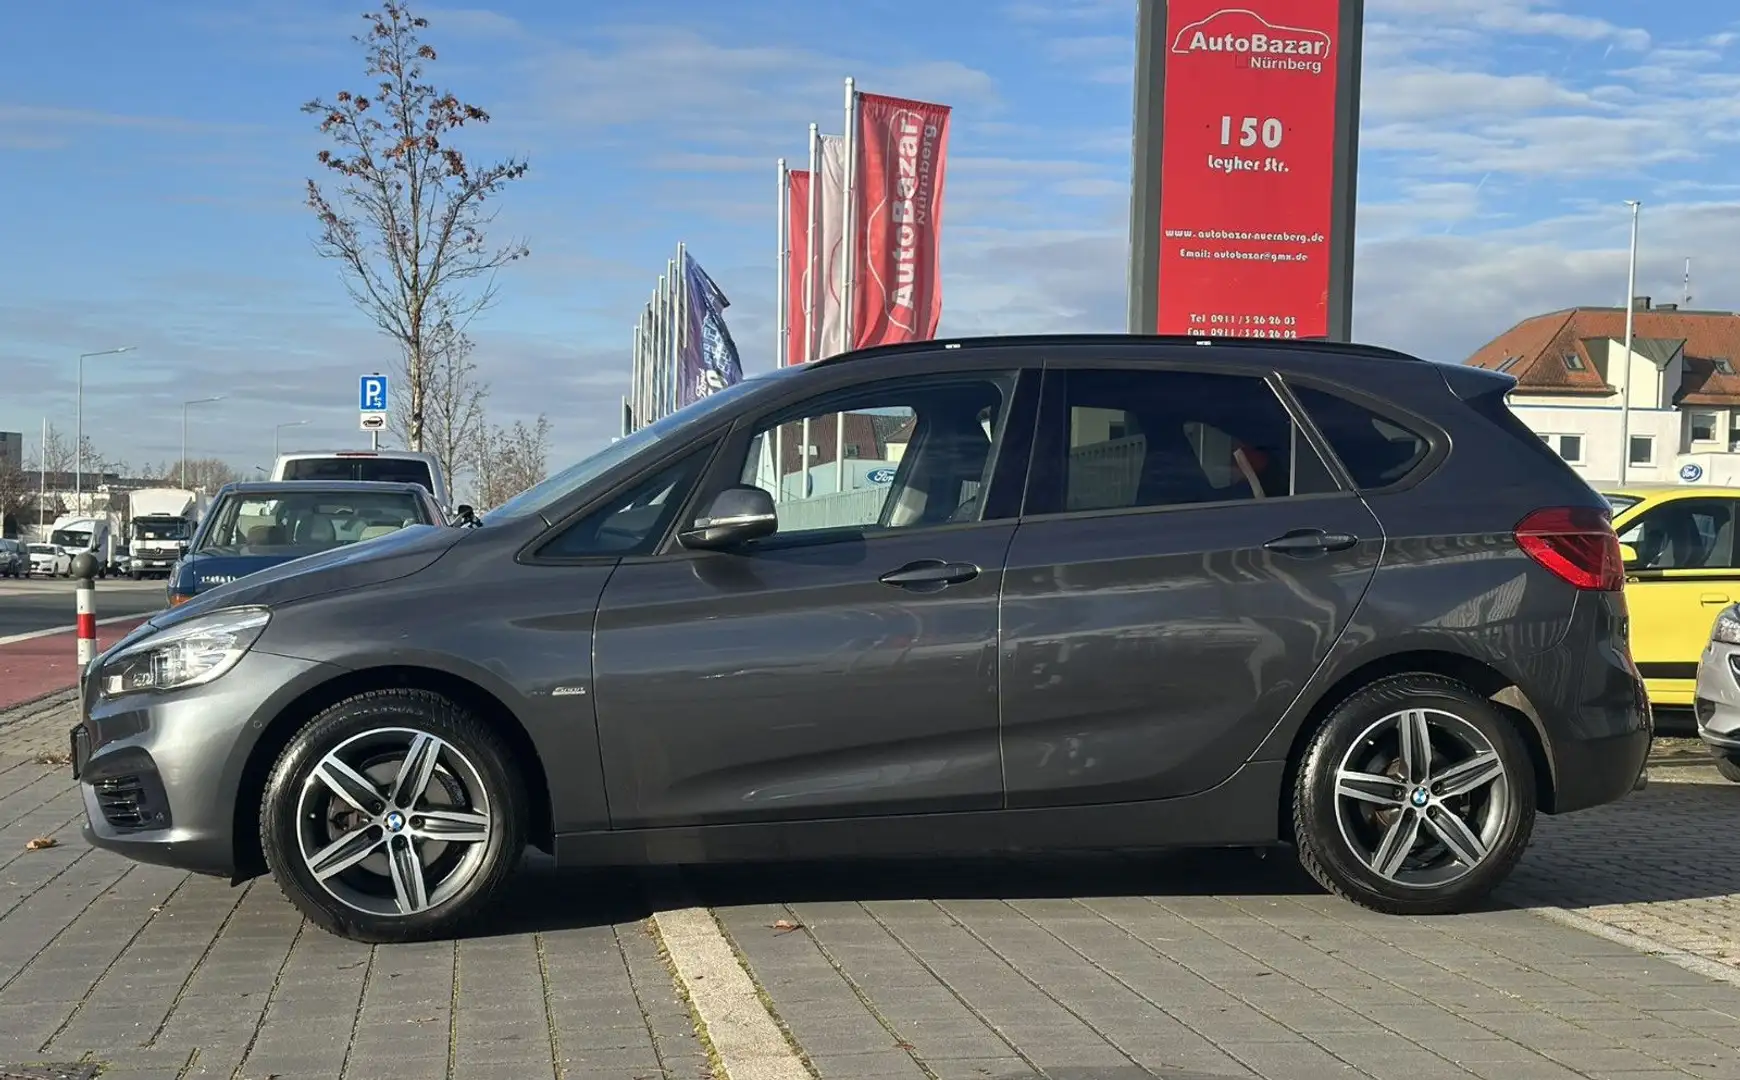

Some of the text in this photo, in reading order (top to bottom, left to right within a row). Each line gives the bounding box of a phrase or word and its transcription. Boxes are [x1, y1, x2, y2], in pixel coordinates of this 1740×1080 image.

[1189, 31, 1324, 55] AutoBazar
[1250, 56, 1322, 74] Nürnberg
[1220, 115, 1283, 148] 150
[916, 124, 937, 226] Nürnberg
[1208, 154, 1289, 173] Leyher Str.
[892, 118, 919, 309] AutoBazar
[1179, 248, 1211, 258] Email:
[1190, 313, 1206, 323] Tel
[366, 380, 381, 406] P
